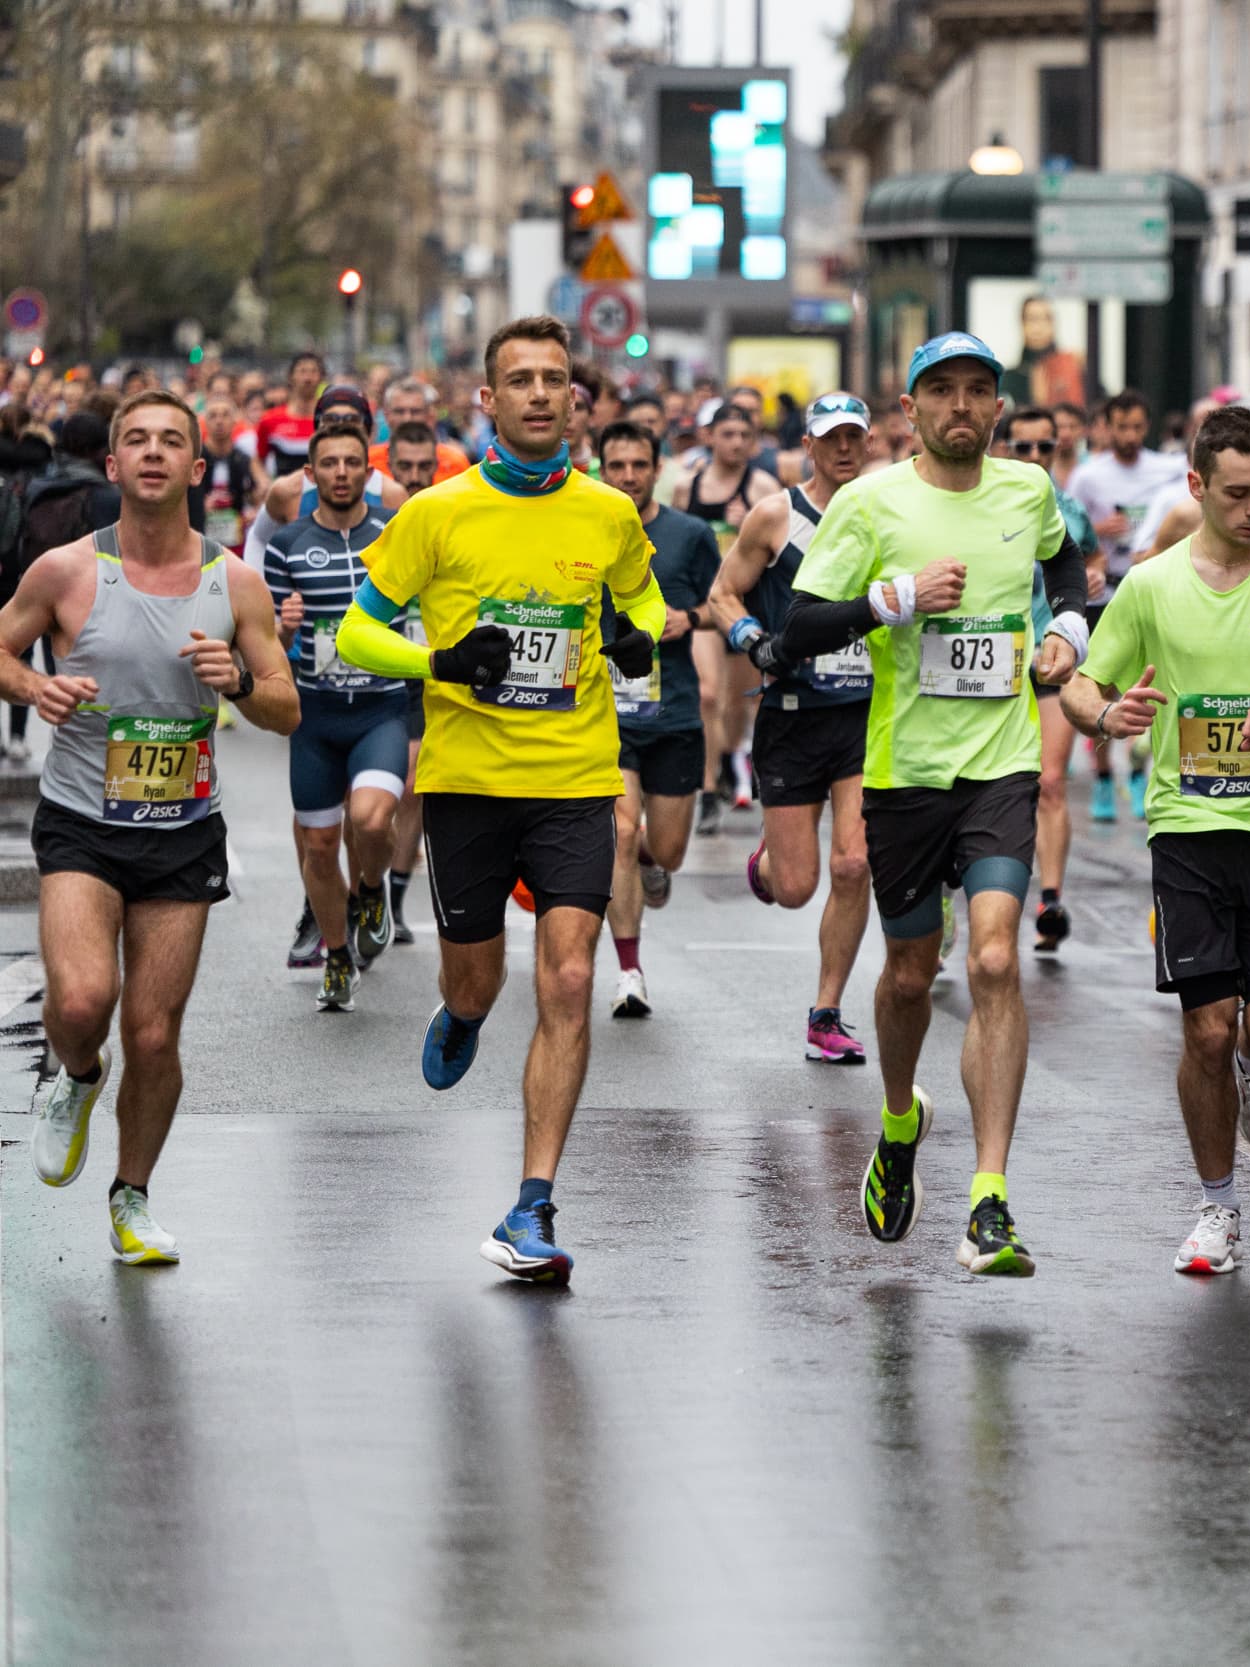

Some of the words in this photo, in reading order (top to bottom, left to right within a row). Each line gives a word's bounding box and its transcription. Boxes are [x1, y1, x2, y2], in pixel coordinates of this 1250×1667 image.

[505, 603, 565, 619] Schneider
[529, 617, 563, 625] Electric
[973, 622, 1005, 631] Electric
[509, 630, 558, 664] 457
[950, 637, 995, 671] 873
[956, 678, 986, 693] Olivier
[514, 691, 549, 705] asics
[134, 719, 193, 733] Schneider
[127, 745, 188, 778] 4757
[1217, 760, 1240, 776] hugo
[143, 784, 166, 801] Ryan
[149, 804, 183, 819] asics
